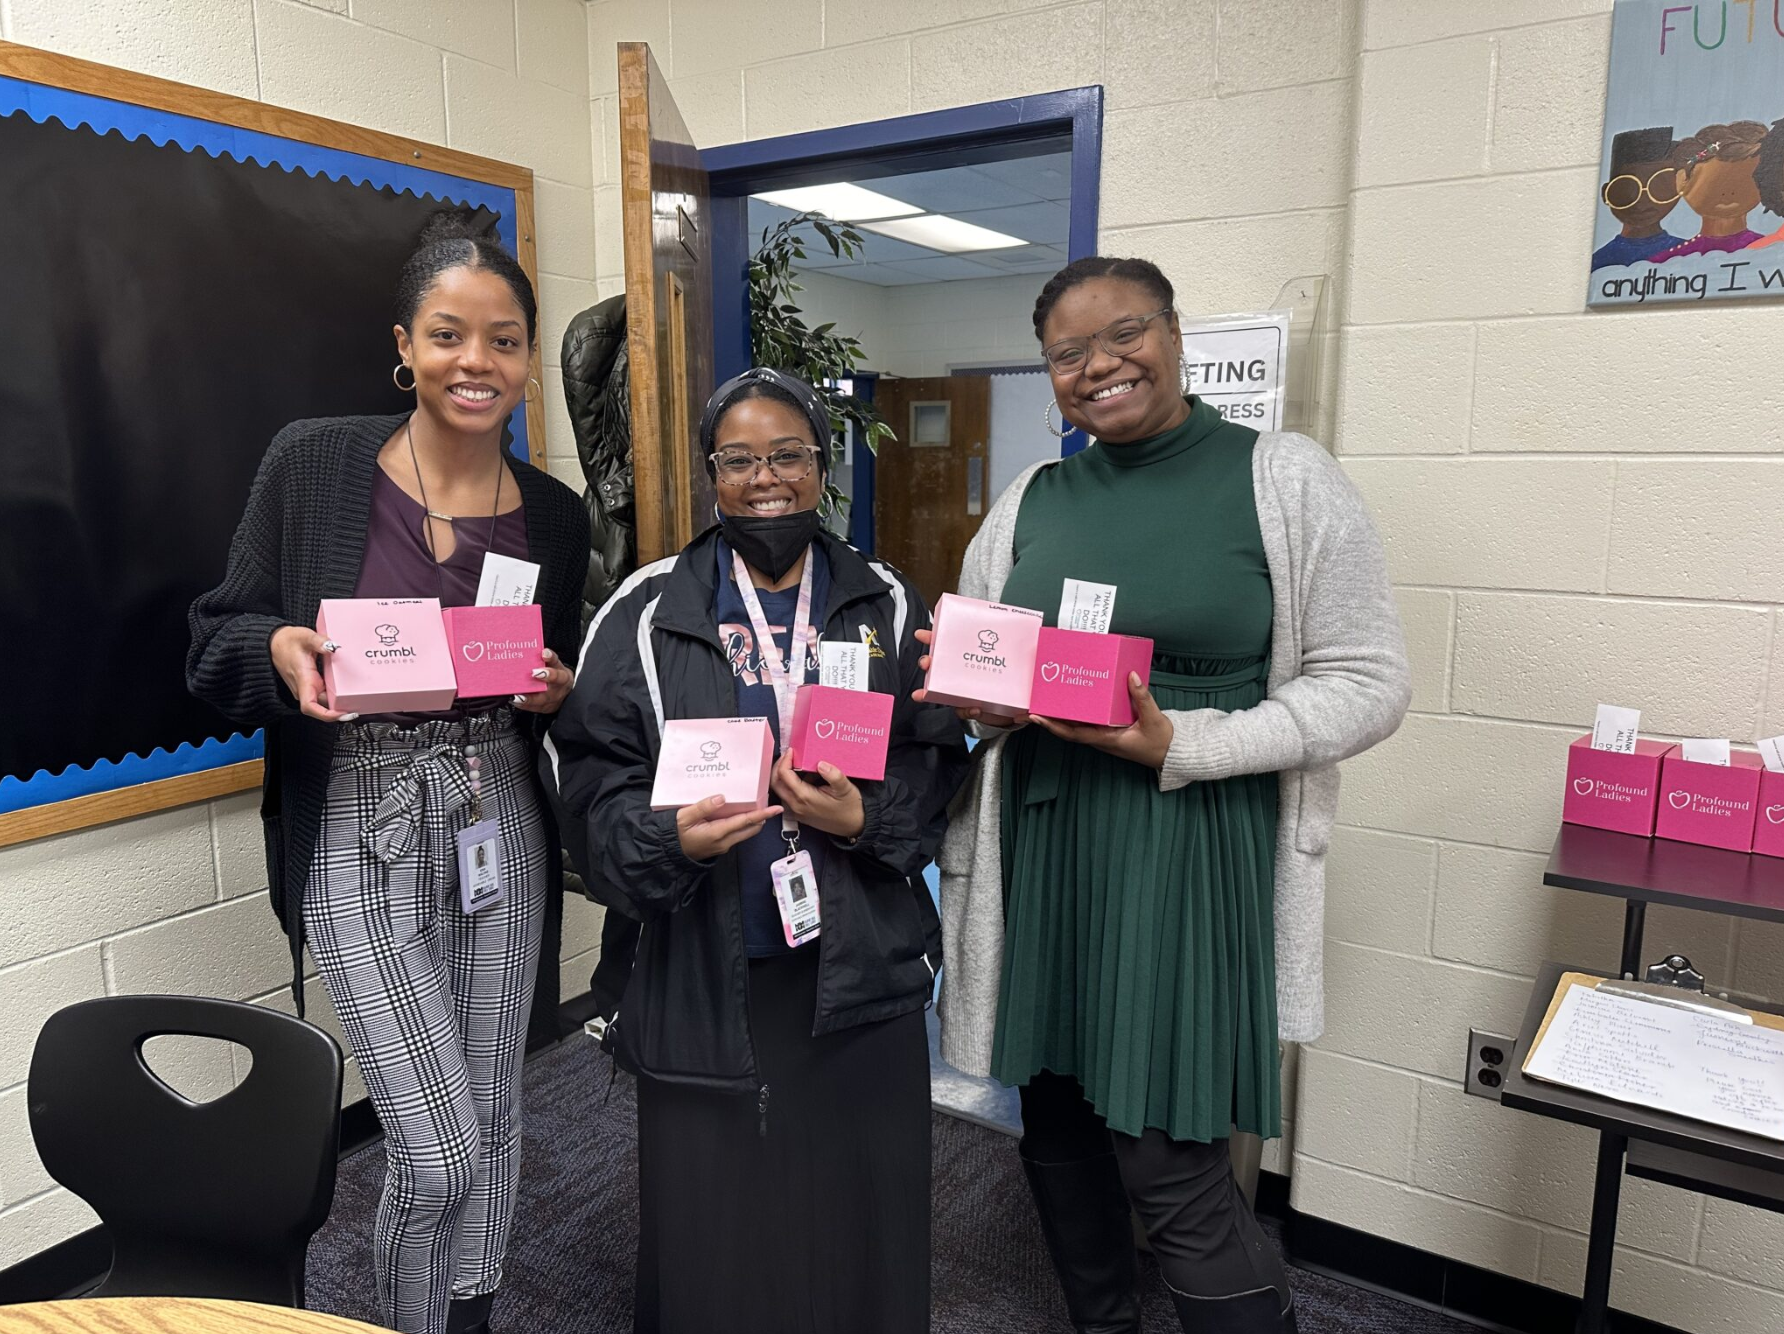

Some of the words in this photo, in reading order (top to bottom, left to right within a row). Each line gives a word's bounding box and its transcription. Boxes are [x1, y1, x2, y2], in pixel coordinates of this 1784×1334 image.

[1602, 268, 1707, 302] anything
[1718, 262, 1750, 292] I
[1188, 359, 1266, 384] ETING
[1218, 402, 1264, 419] RESS
[514, 586, 522, 600] ALL
[522, 585, 533, 606] THAN
[1093, 594, 1102, 608] ALL
[1100, 591, 1112, 618] THANK
[1090, 610, 1099, 630] THAT
[365, 646, 416, 659] crumbl
[486, 638, 538, 652] Profound
[486, 650, 524, 661] Ladies
[849, 647, 857, 672] THANK
[963, 652, 1006, 668] crumbl
[964, 662, 1002, 674] cookies
[1062, 664, 1110, 679] Profound
[1060, 674, 1094, 687] Ladies
[836, 721, 884, 737] Profound
[836, 732, 869, 744] Ladies
[1624, 728, 1634, 752] THANK
[686, 762, 730, 772] crumbl
[1596, 780, 1648, 796] Profound
[1595, 790, 1632, 802] Ladies
[1693, 794, 1750, 810] Profound
[1692, 802, 1731, 817] Ladies
